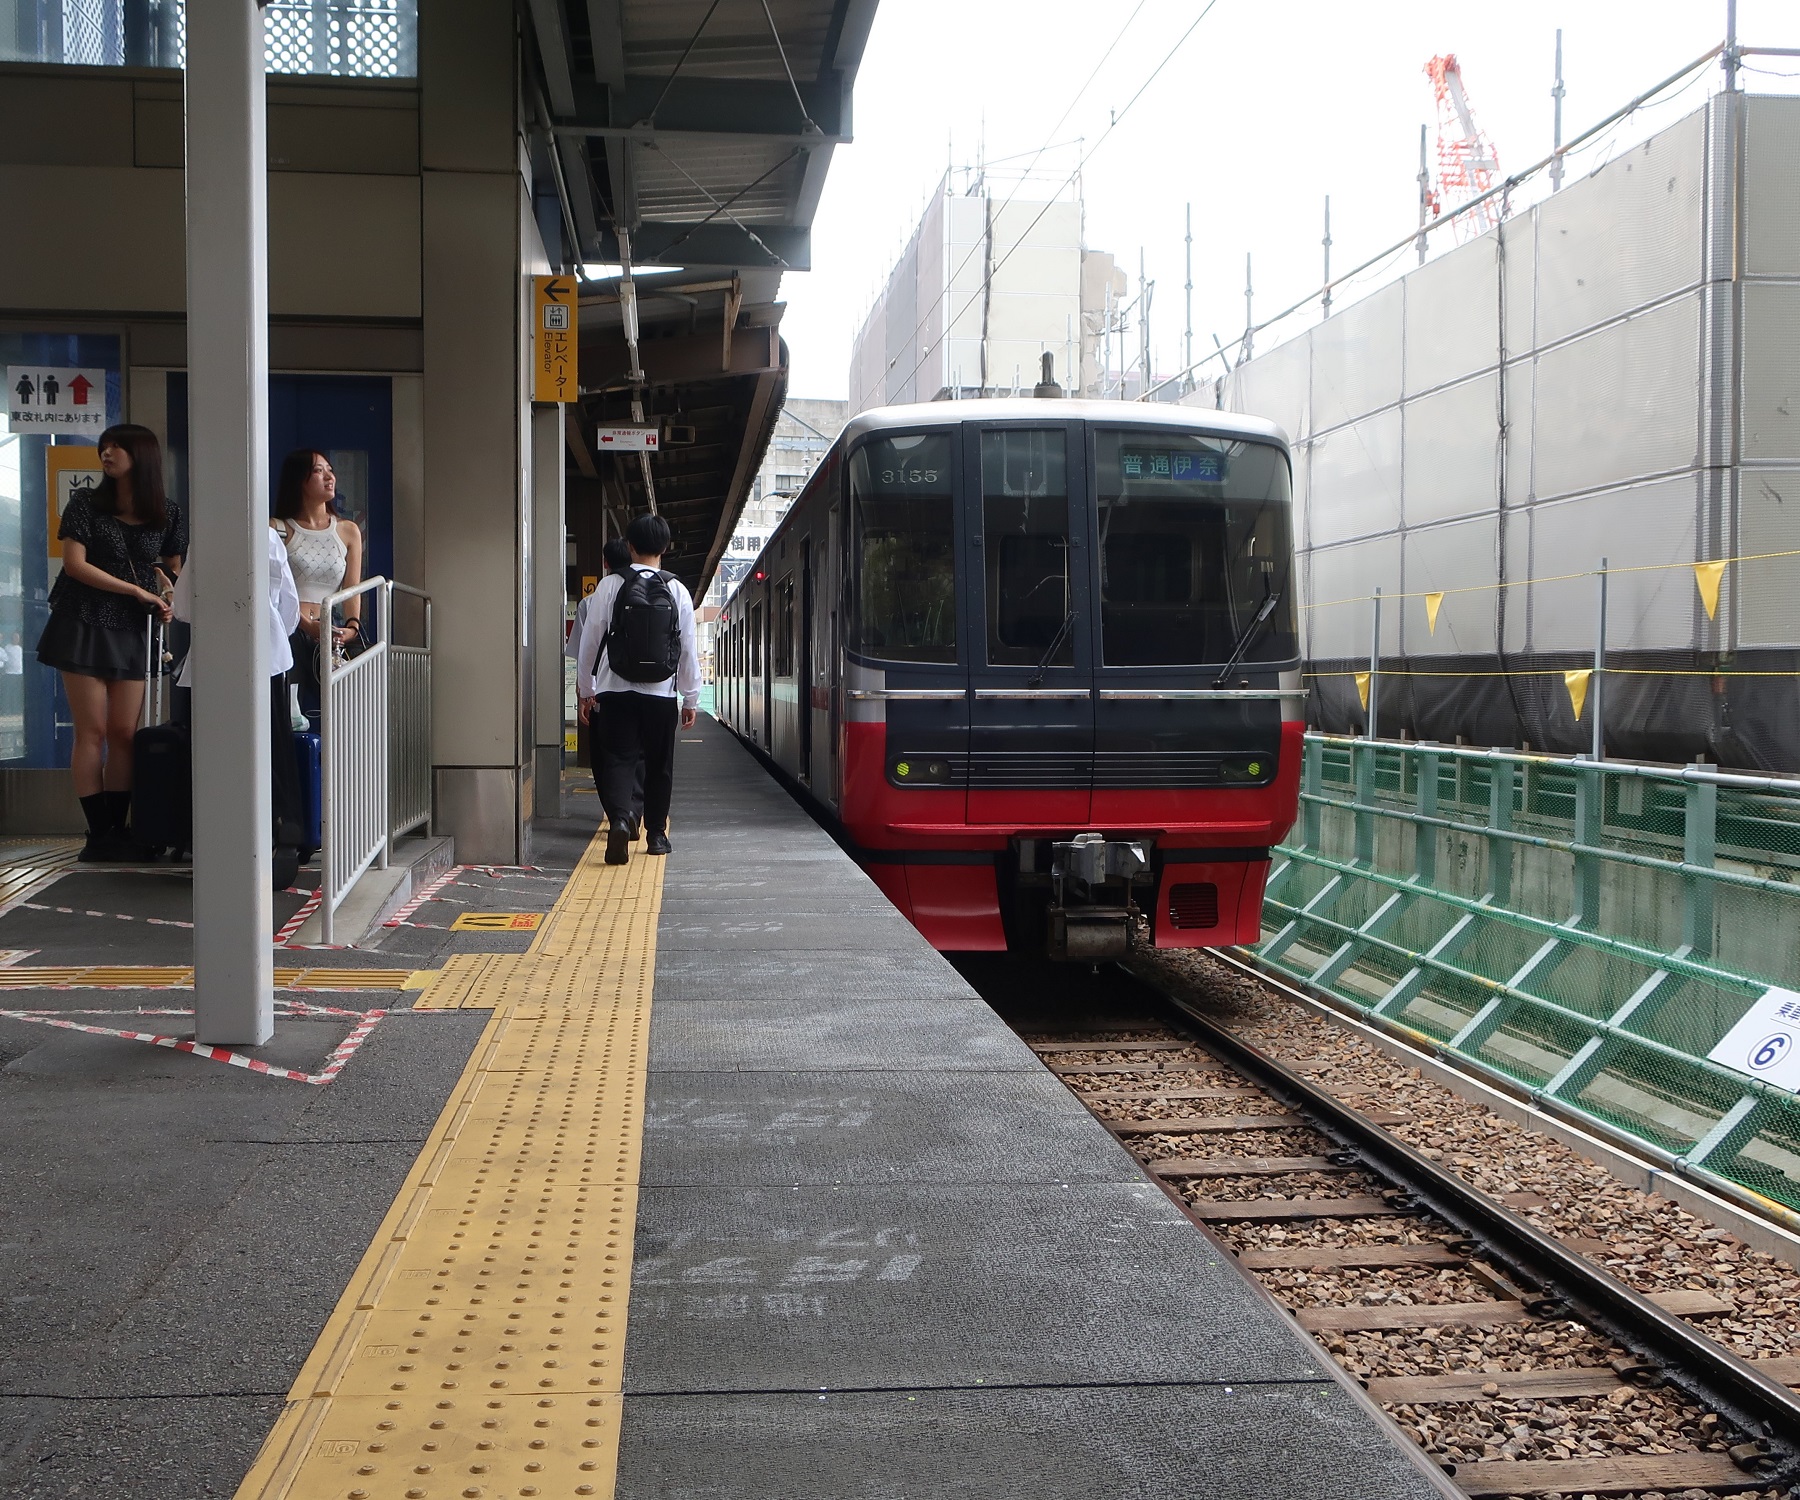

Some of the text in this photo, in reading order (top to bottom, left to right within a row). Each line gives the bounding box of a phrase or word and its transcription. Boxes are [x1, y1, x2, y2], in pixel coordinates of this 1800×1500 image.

[544, 332, 553, 374] Elevator
[554, 332, 568, 398] エレベーター
[11, 411, 102, 424] 東改札内にあります
[1123, 454, 1218, 476] 普通 伊奈
[881, 469, 938, 484] 3155
